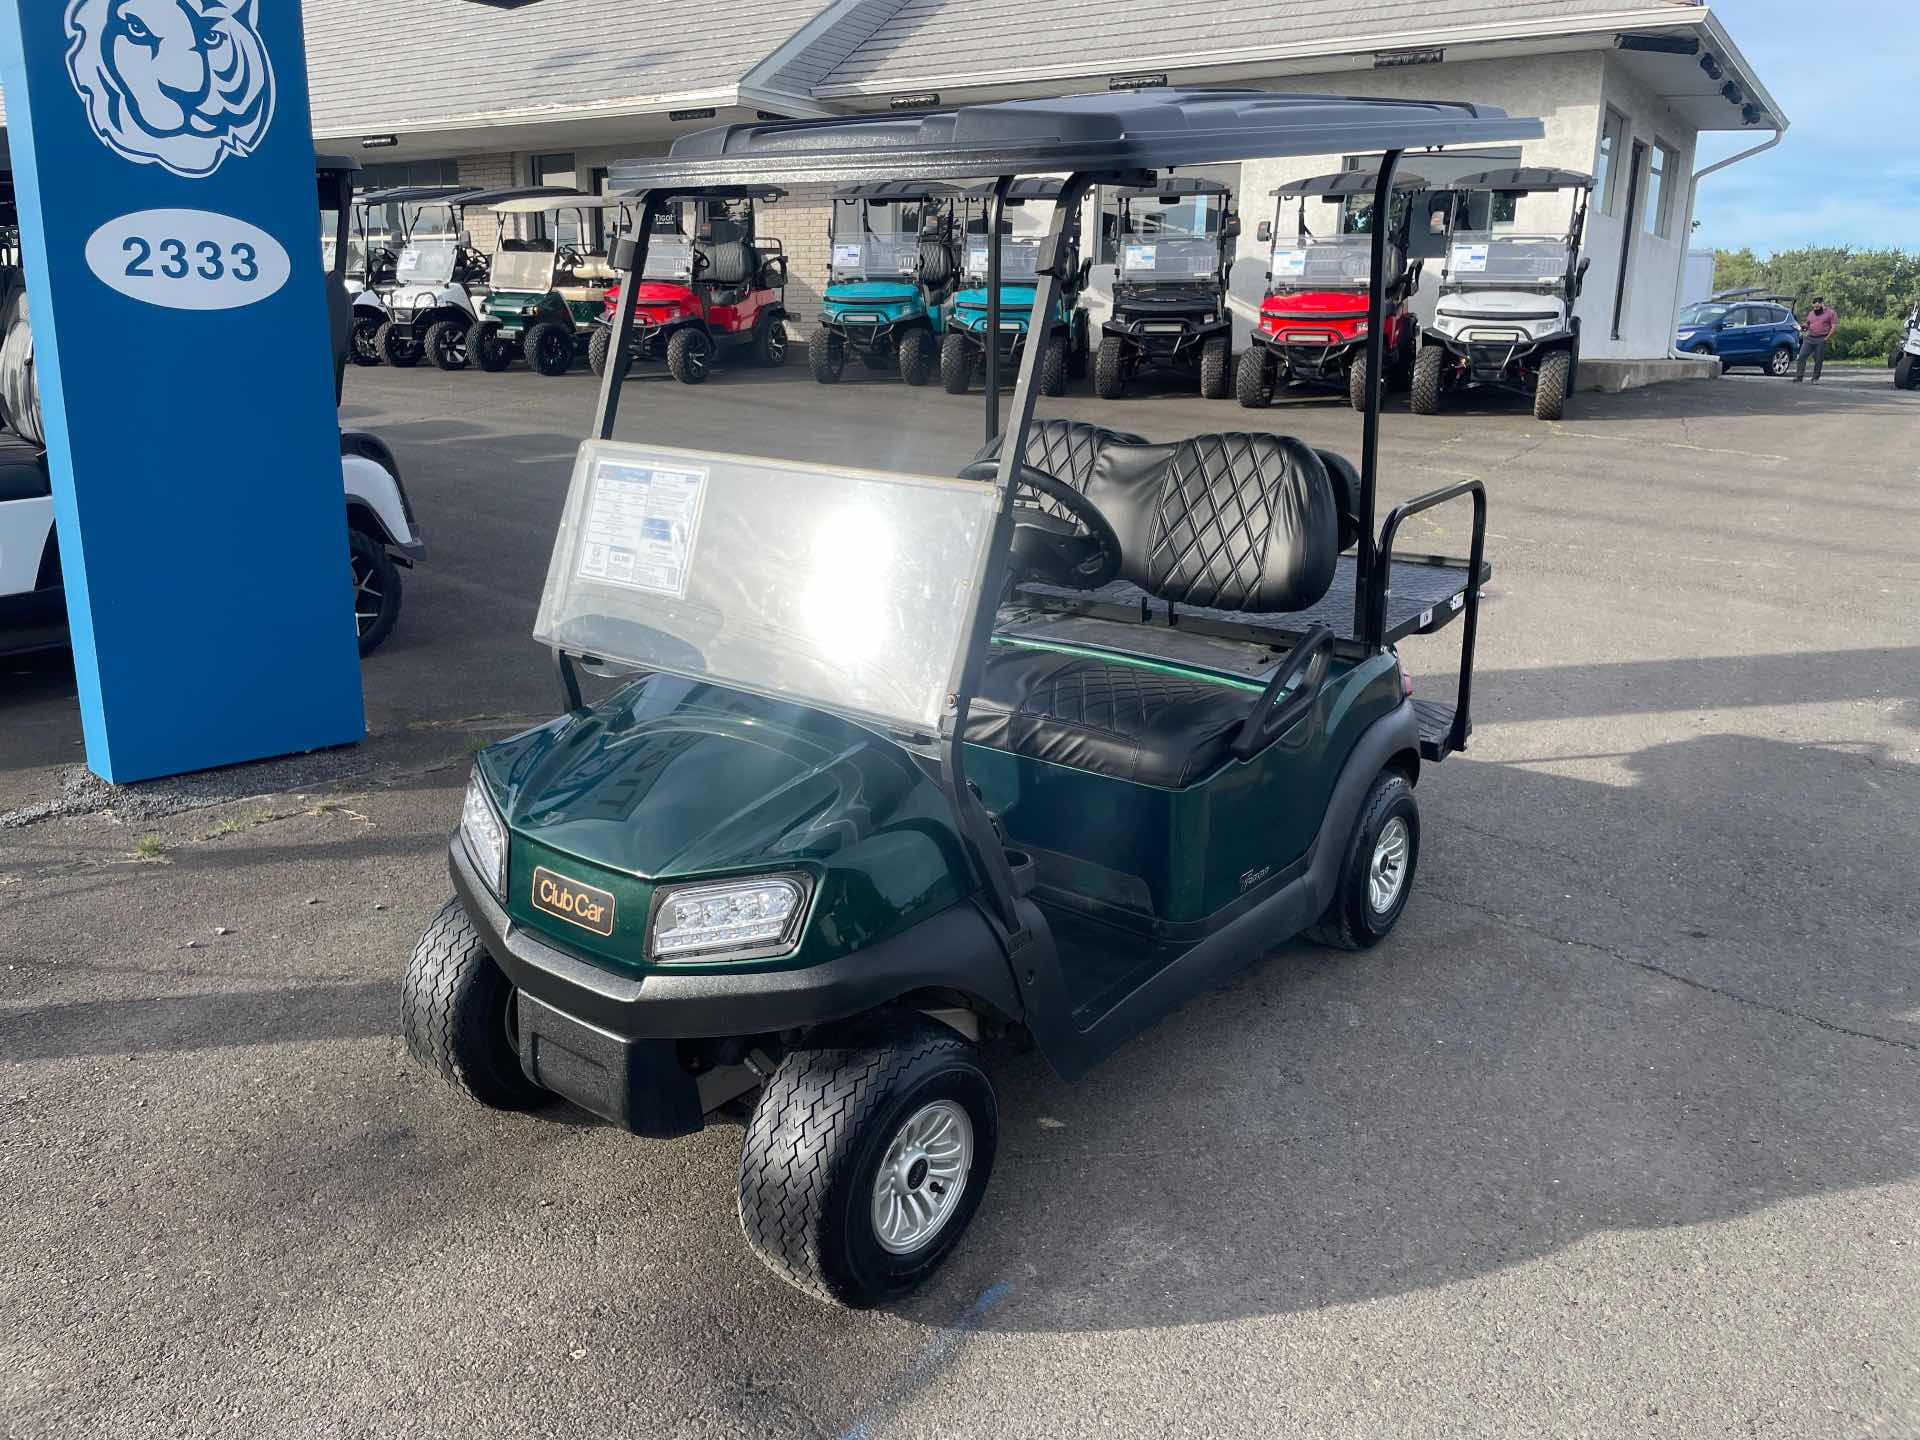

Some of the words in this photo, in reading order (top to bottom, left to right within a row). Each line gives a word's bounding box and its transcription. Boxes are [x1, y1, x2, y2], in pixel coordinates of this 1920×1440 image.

[122, 236, 259, 282] 2333
[540, 880, 573, 911] Club
[575, 894, 605, 922] Car
